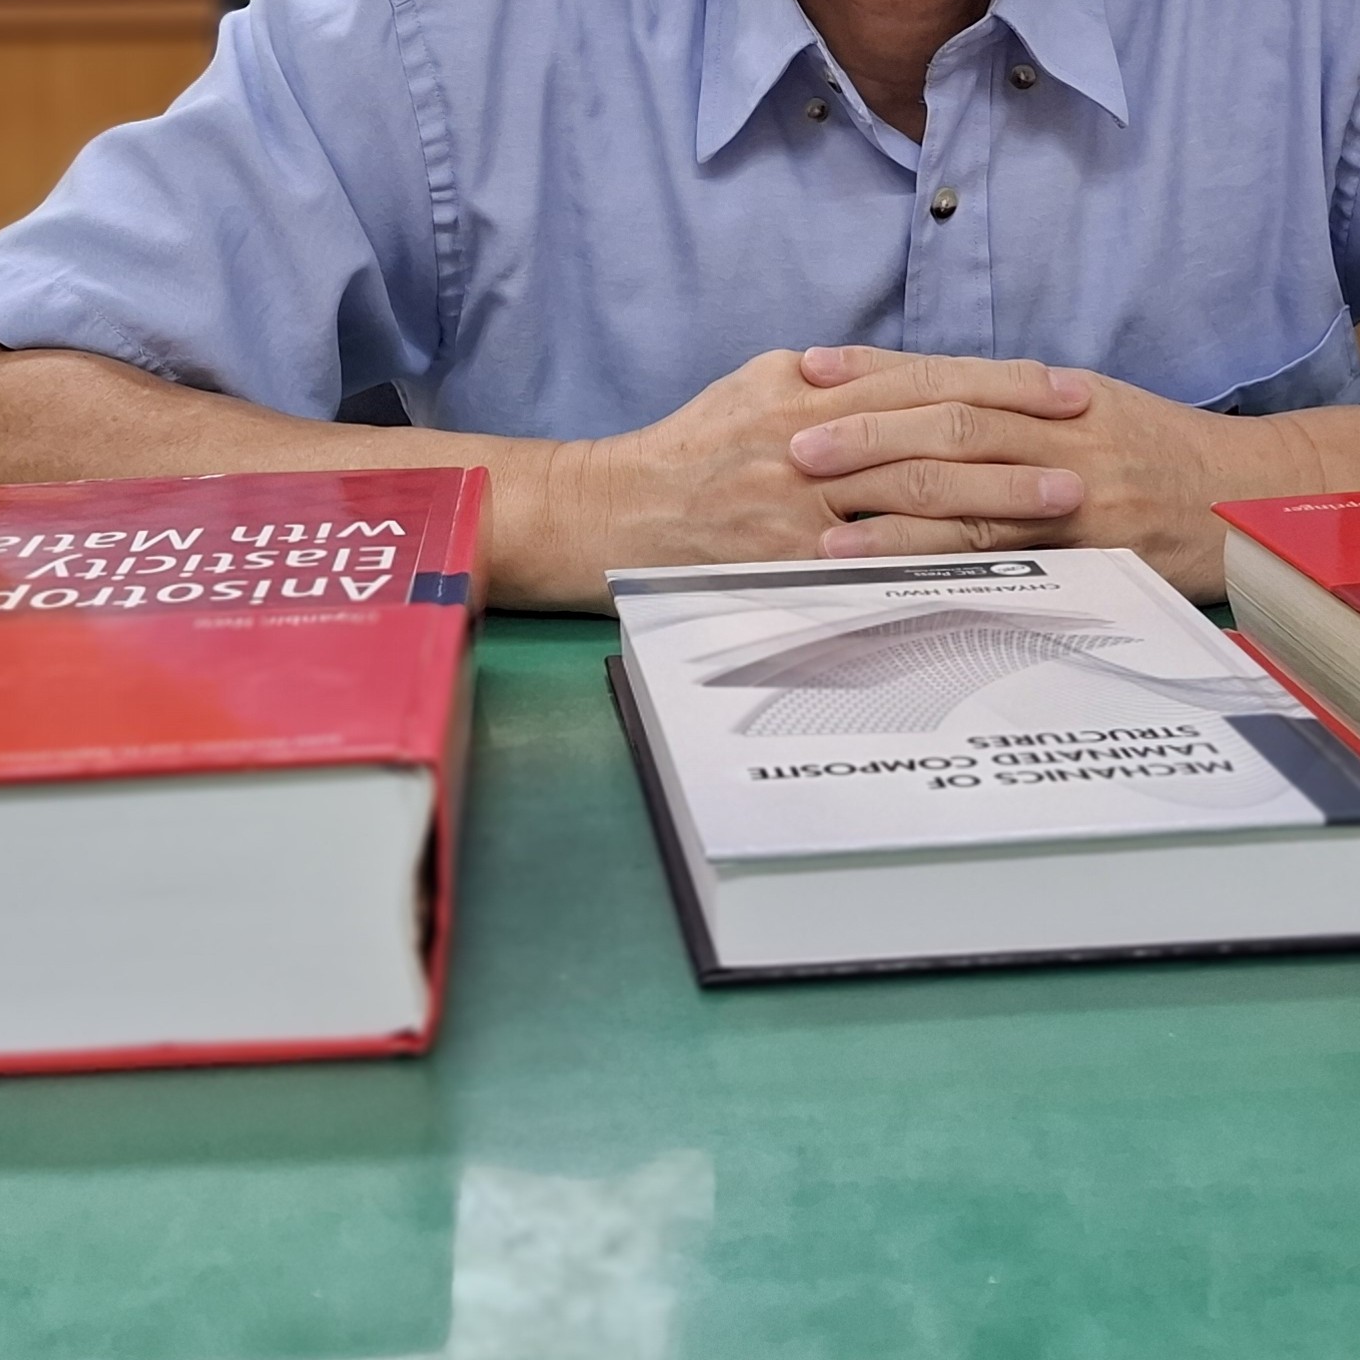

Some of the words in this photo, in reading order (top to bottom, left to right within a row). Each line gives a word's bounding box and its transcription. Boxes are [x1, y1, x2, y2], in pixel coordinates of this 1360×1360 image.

[230, 518, 407, 547] with
[25, 545, 398, 582] Elasticity
[885, 588, 940, 598] HWU
[945, 582, 1060, 594] CHYANBIN
[965, 724, 1201, 750] STRUCTURES
[990, 741, 1218, 767] LAMINATED
[747, 754, 978, 782] COMPOSITE
[926, 772, 982, 790] OF
[994, 759, 1234, 787] MECHANICS
